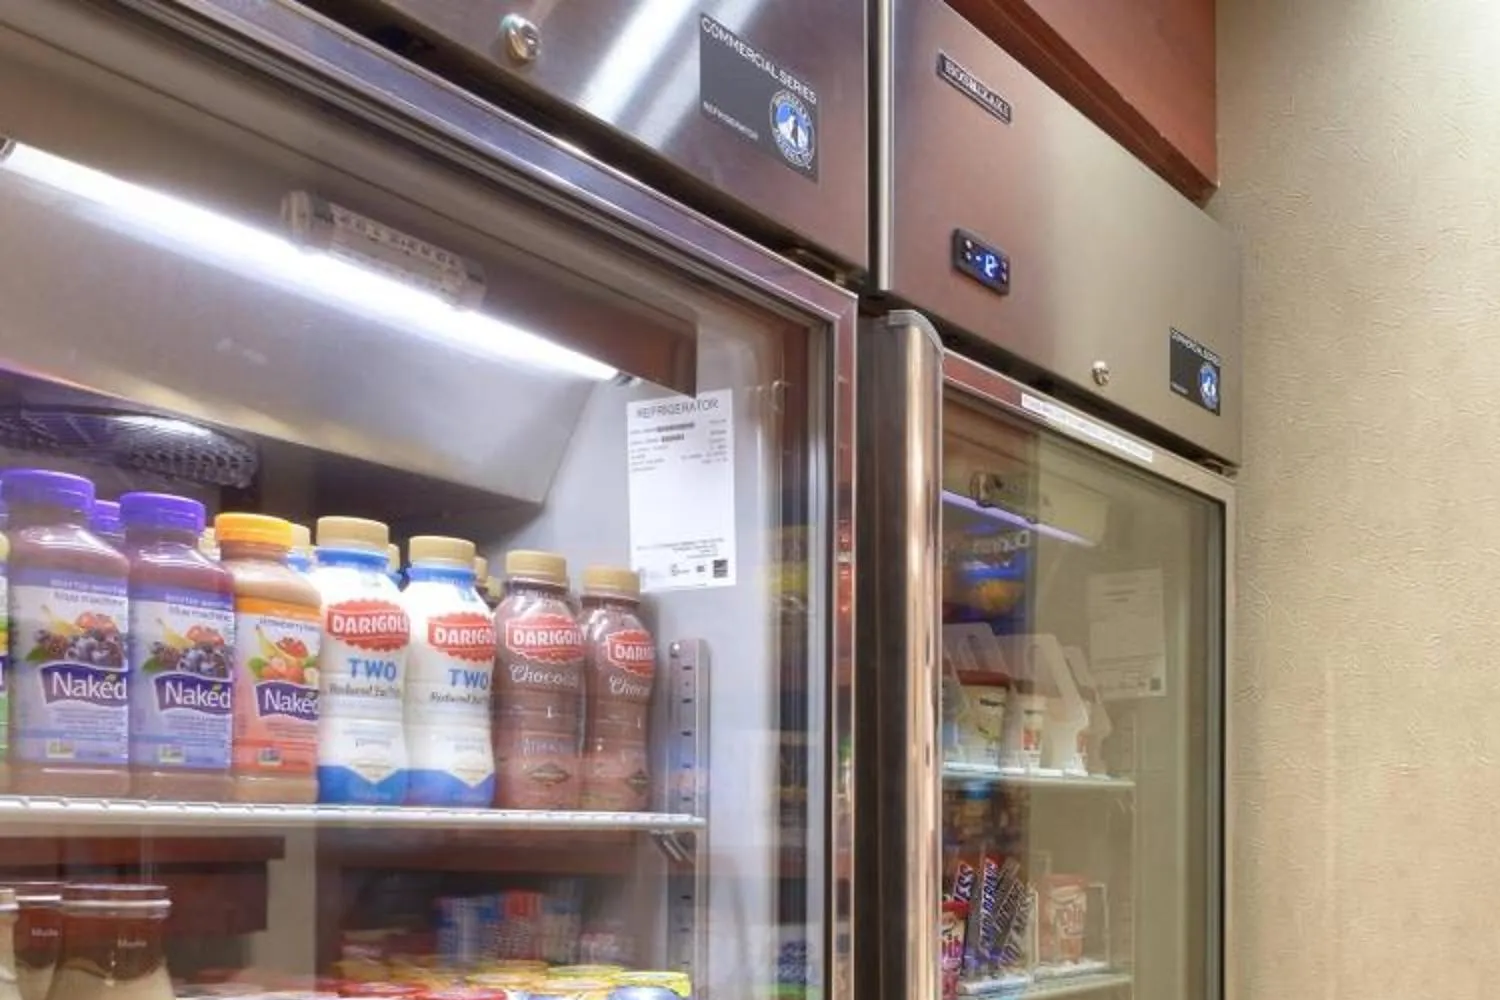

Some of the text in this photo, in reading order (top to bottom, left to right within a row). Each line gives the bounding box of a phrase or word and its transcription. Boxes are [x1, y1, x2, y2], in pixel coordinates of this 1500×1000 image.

[701, 17, 817, 105] COMMERCIAL SERIES
[636, 399, 720, 419] REFRIGERATOR
[332, 614, 409, 634] DARIGOL
[513, 629, 582, 646] DARIGOL
[348, 657, 397, 682] TWO
[447, 668, 489, 691] TWO
[52, 670, 128, 700] Naked
[164, 681, 231, 709] Naked
